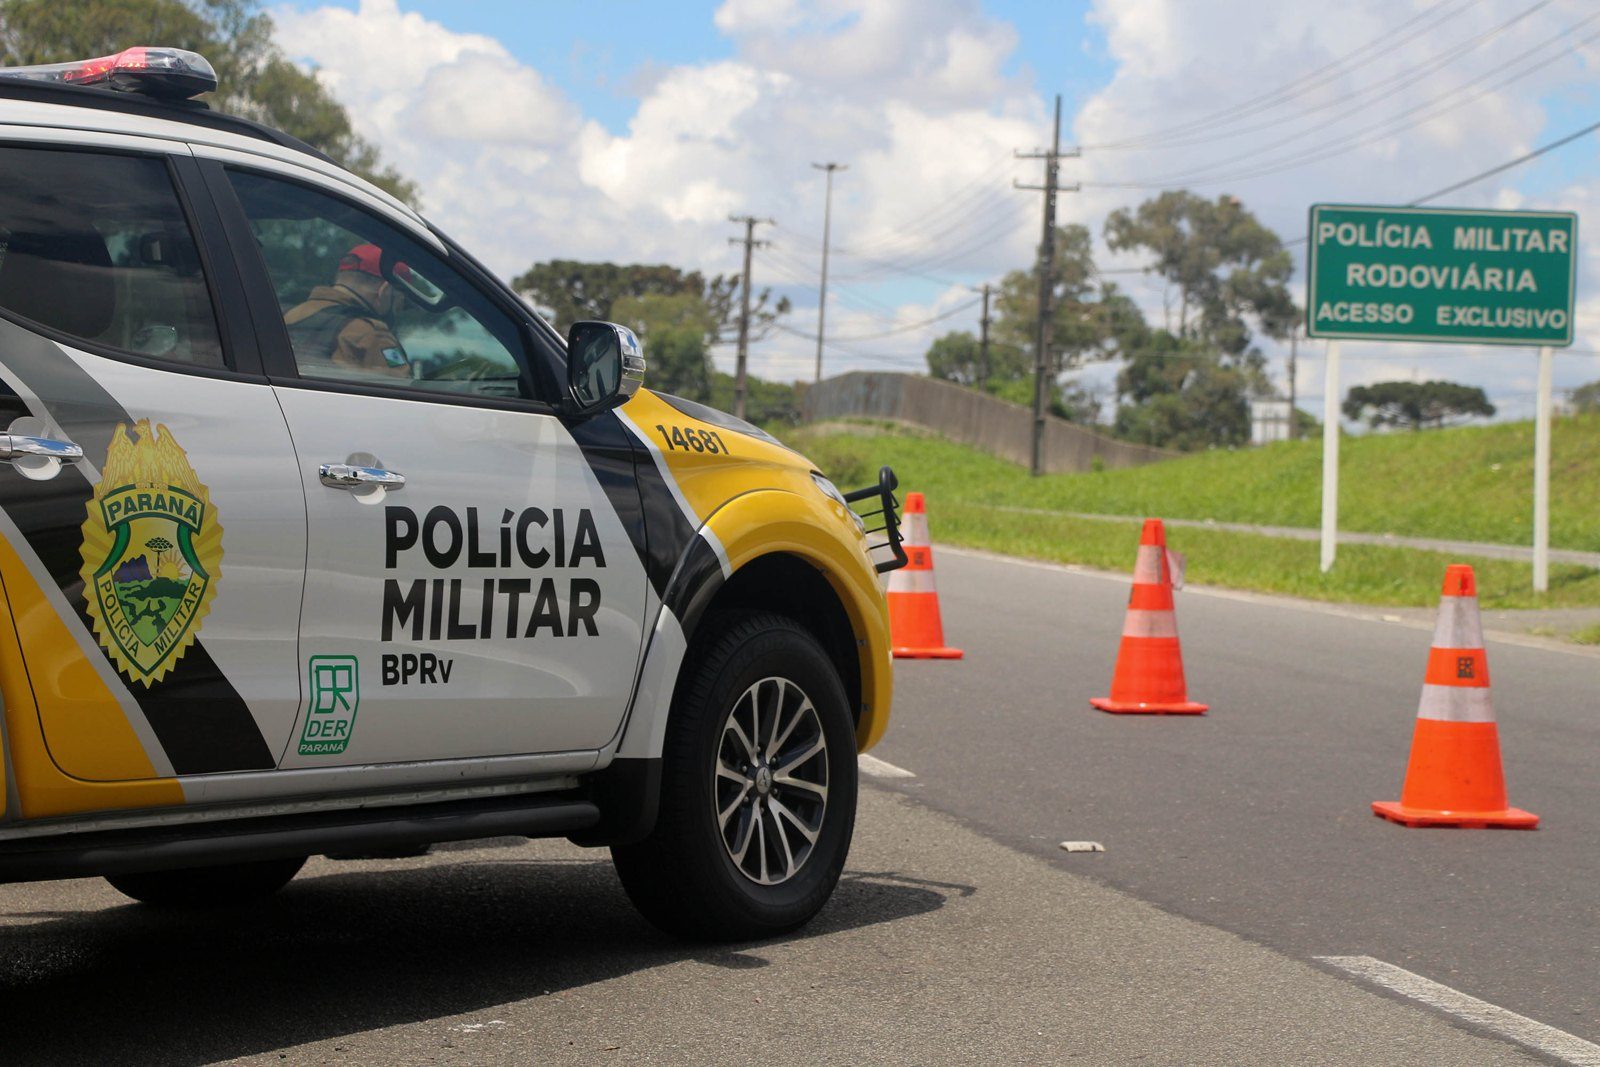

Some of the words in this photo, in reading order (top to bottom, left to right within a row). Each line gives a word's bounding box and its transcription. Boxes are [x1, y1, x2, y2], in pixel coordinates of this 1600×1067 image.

[1317, 219, 1432, 249] POLÍCIA
[1454, 227, 1568, 253] MILITAR
[1346, 262, 1537, 292] RODOVIÁRIA
[1316, 302, 1414, 324] ACESSO
[1437, 305, 1567, 329] EXCLUSIVO
[656, 425, 729, 455] 14681
[107, 494, 199, 525] PARANÁ
[101, 579, 140, 658] POLÍCIA
[154, 582, 201, 656] MILITAR
[381, 577, 601, 642] MILITAR
[381, 653, 453, 686] BPRv
[307, 720, 348, 738] DER
[299, 741, 345, 753] PARANÁ
